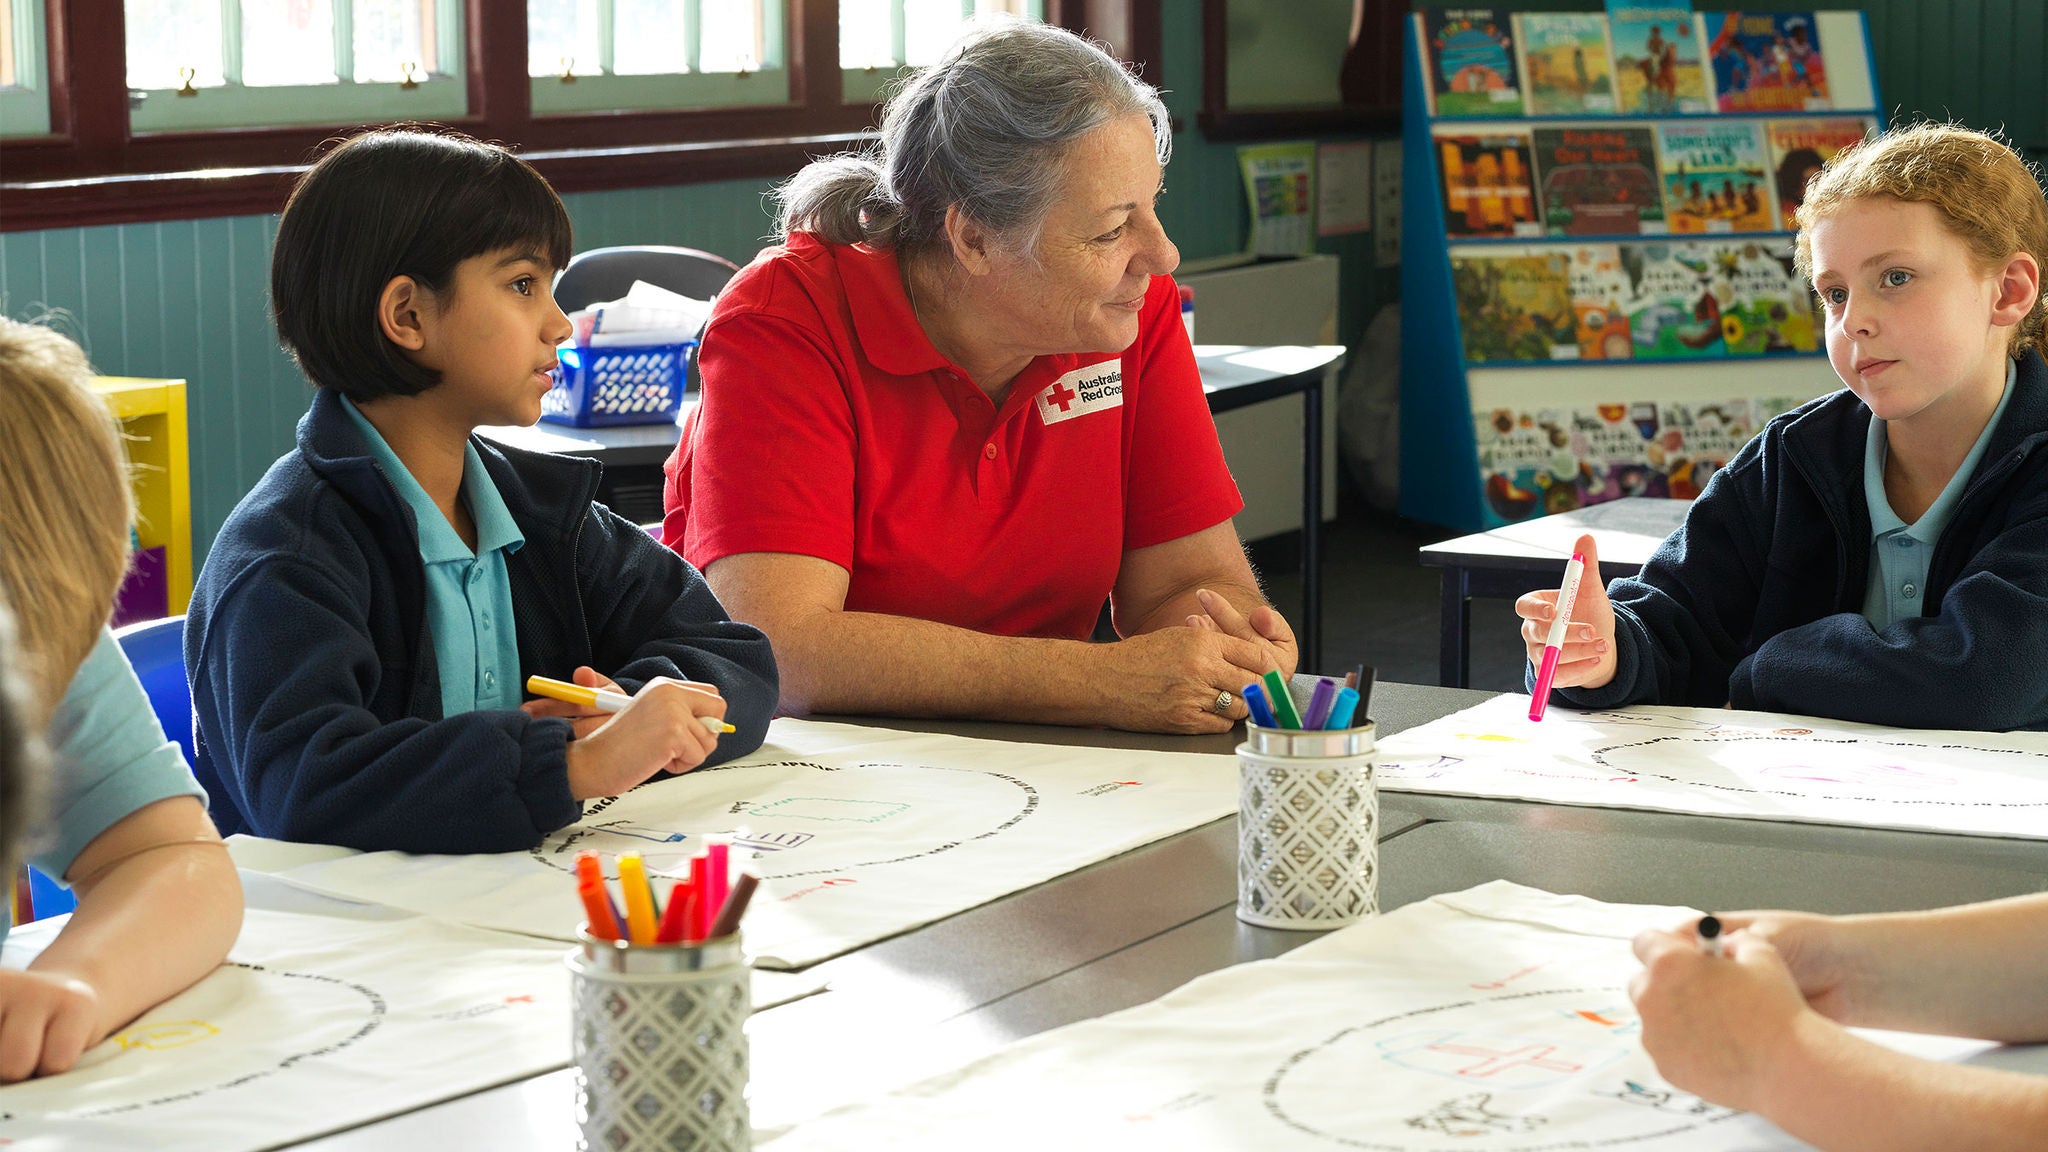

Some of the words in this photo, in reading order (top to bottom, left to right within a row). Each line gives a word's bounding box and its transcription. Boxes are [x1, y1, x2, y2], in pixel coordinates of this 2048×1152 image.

[1078, 371, 1122, 391] Australia
[1080, 387, 1104, 403] Red
[1103, 385, 1122, 397] Cros
